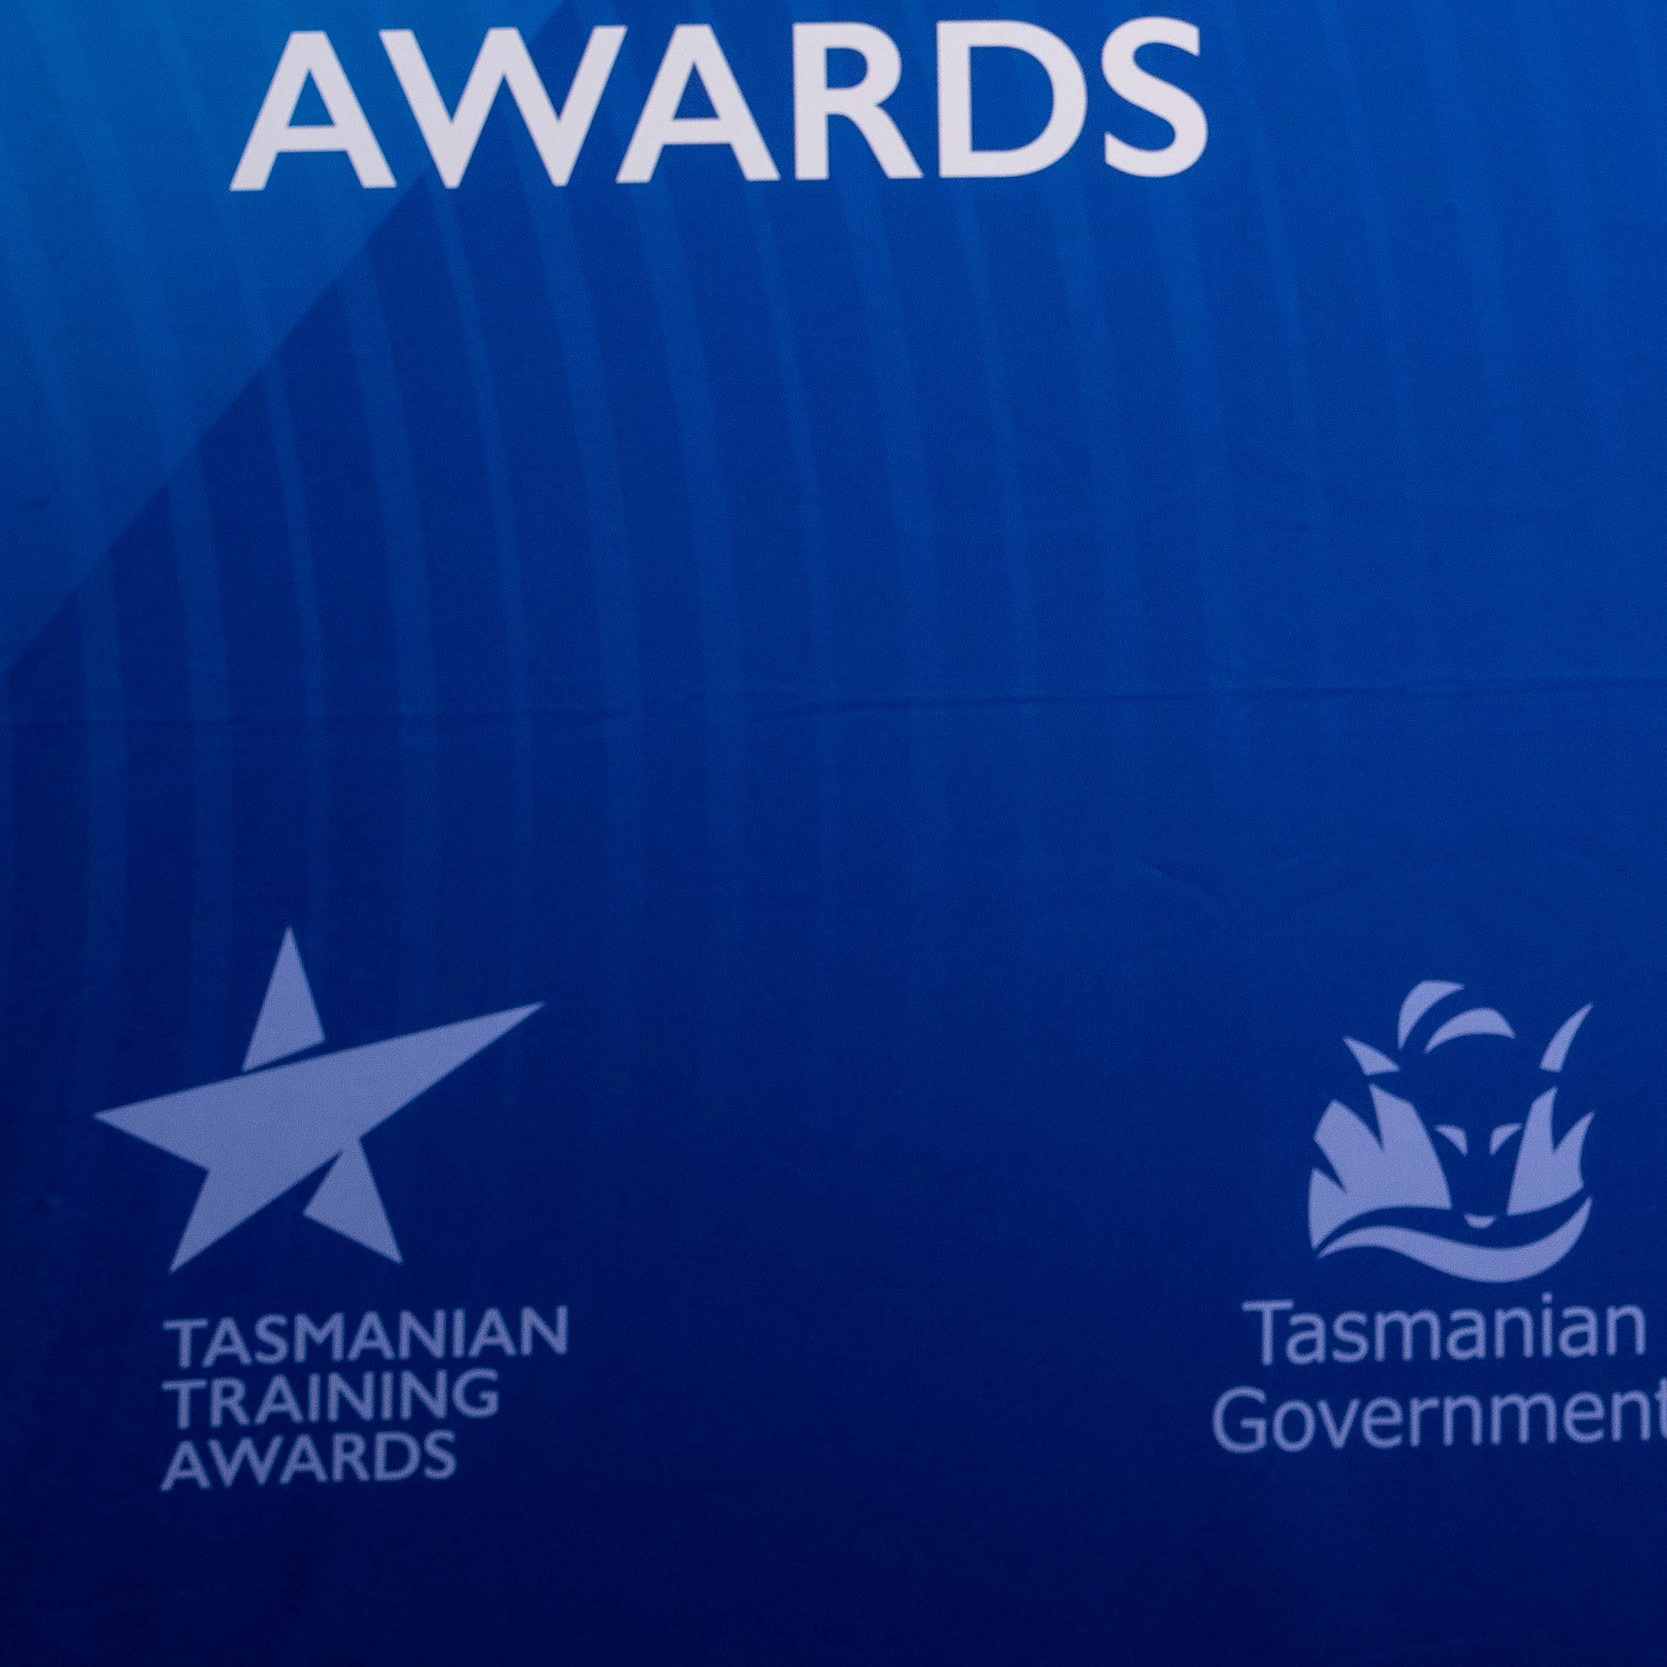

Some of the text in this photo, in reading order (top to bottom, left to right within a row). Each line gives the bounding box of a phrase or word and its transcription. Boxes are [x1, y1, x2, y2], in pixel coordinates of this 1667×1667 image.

[230, 16, 1208, 191] AWARDS
[163, 1306, 568, 1368] TASMANIAN
[1242, 1292, 1645, 1365] Tasmanian
[162, 1368, 498, 1429] TRAINING
[161, 1430, 456, 1491] AWARDS
